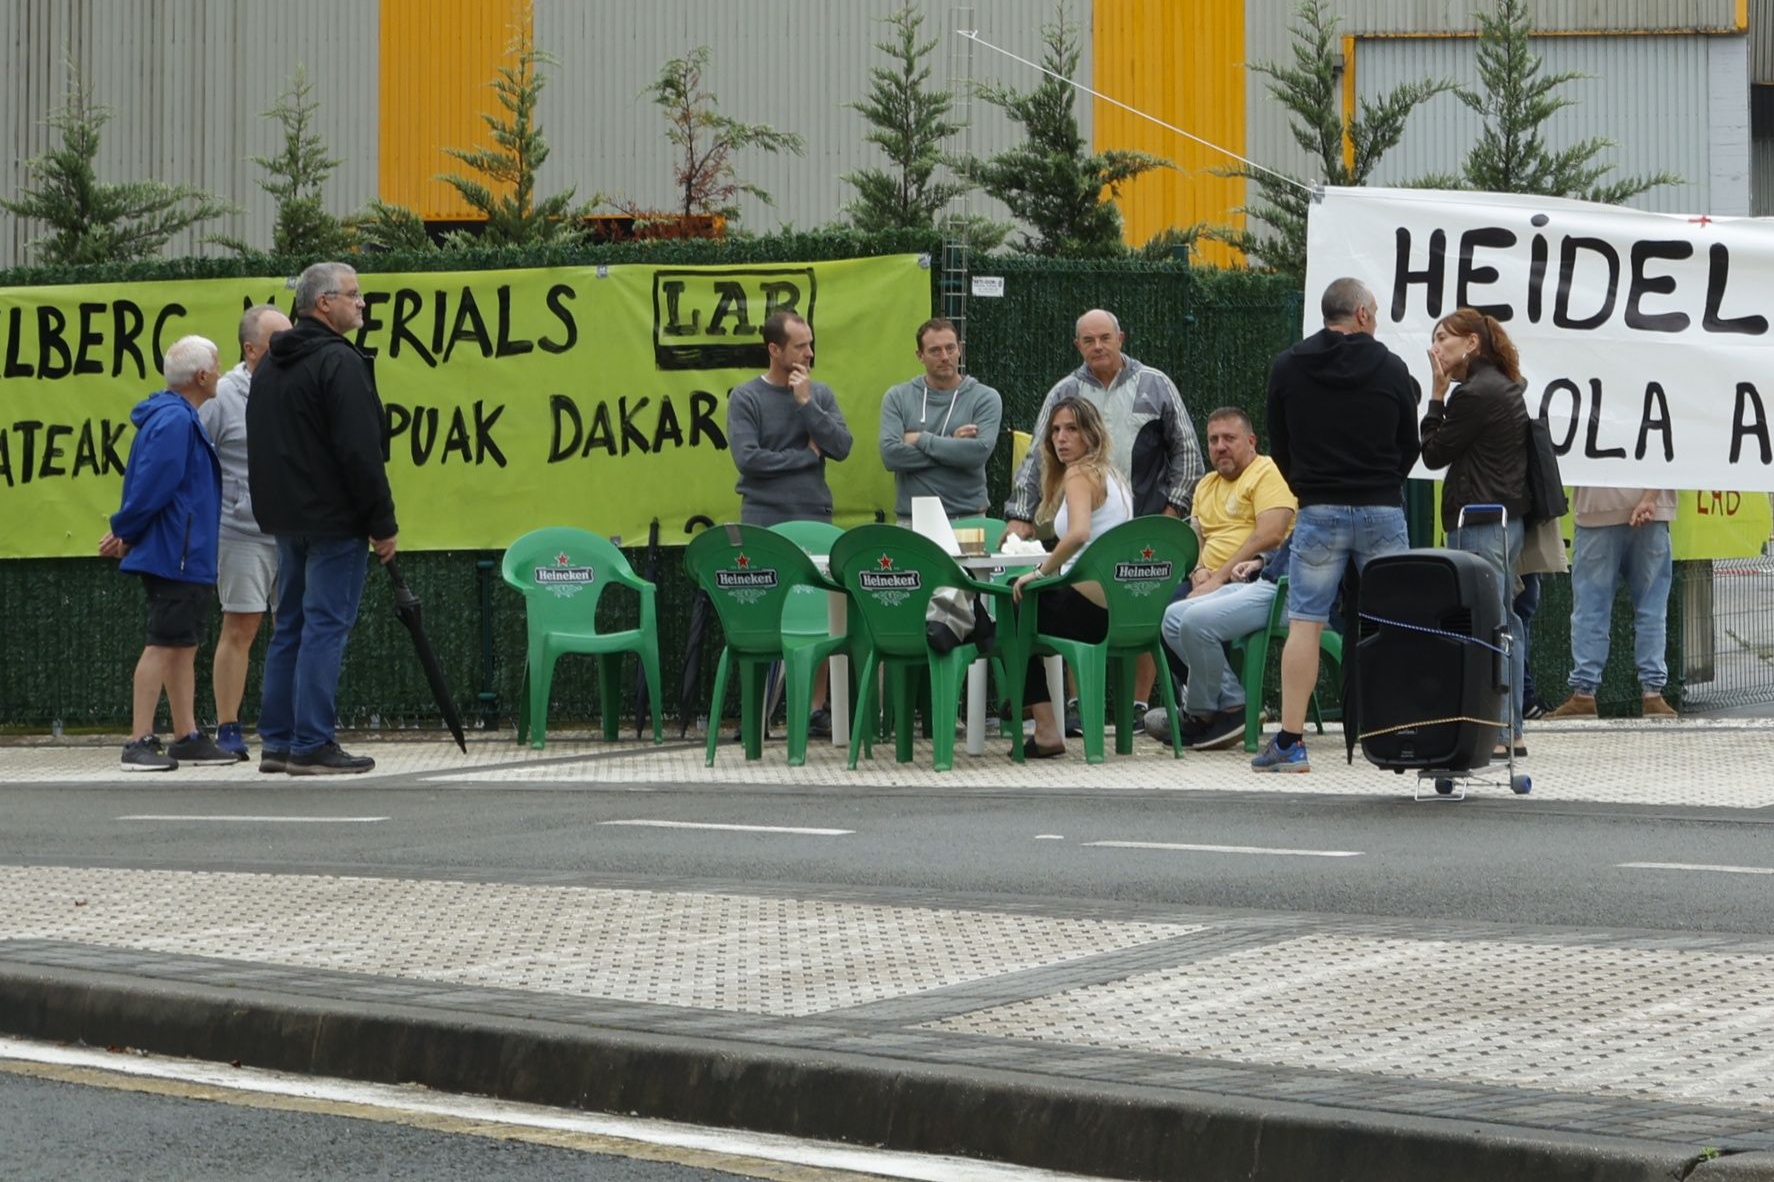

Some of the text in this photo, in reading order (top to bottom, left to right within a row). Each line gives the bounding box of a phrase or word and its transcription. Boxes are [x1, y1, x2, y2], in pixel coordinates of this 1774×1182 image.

[547, 386, 738, 464] DAKAR
[538, 569, 590, 580] Heineken
[1119, 564, 1169, 578] Heineken
[719, 572, 773, 585] Heineken
[862, 573, 917, 587] Heineken
